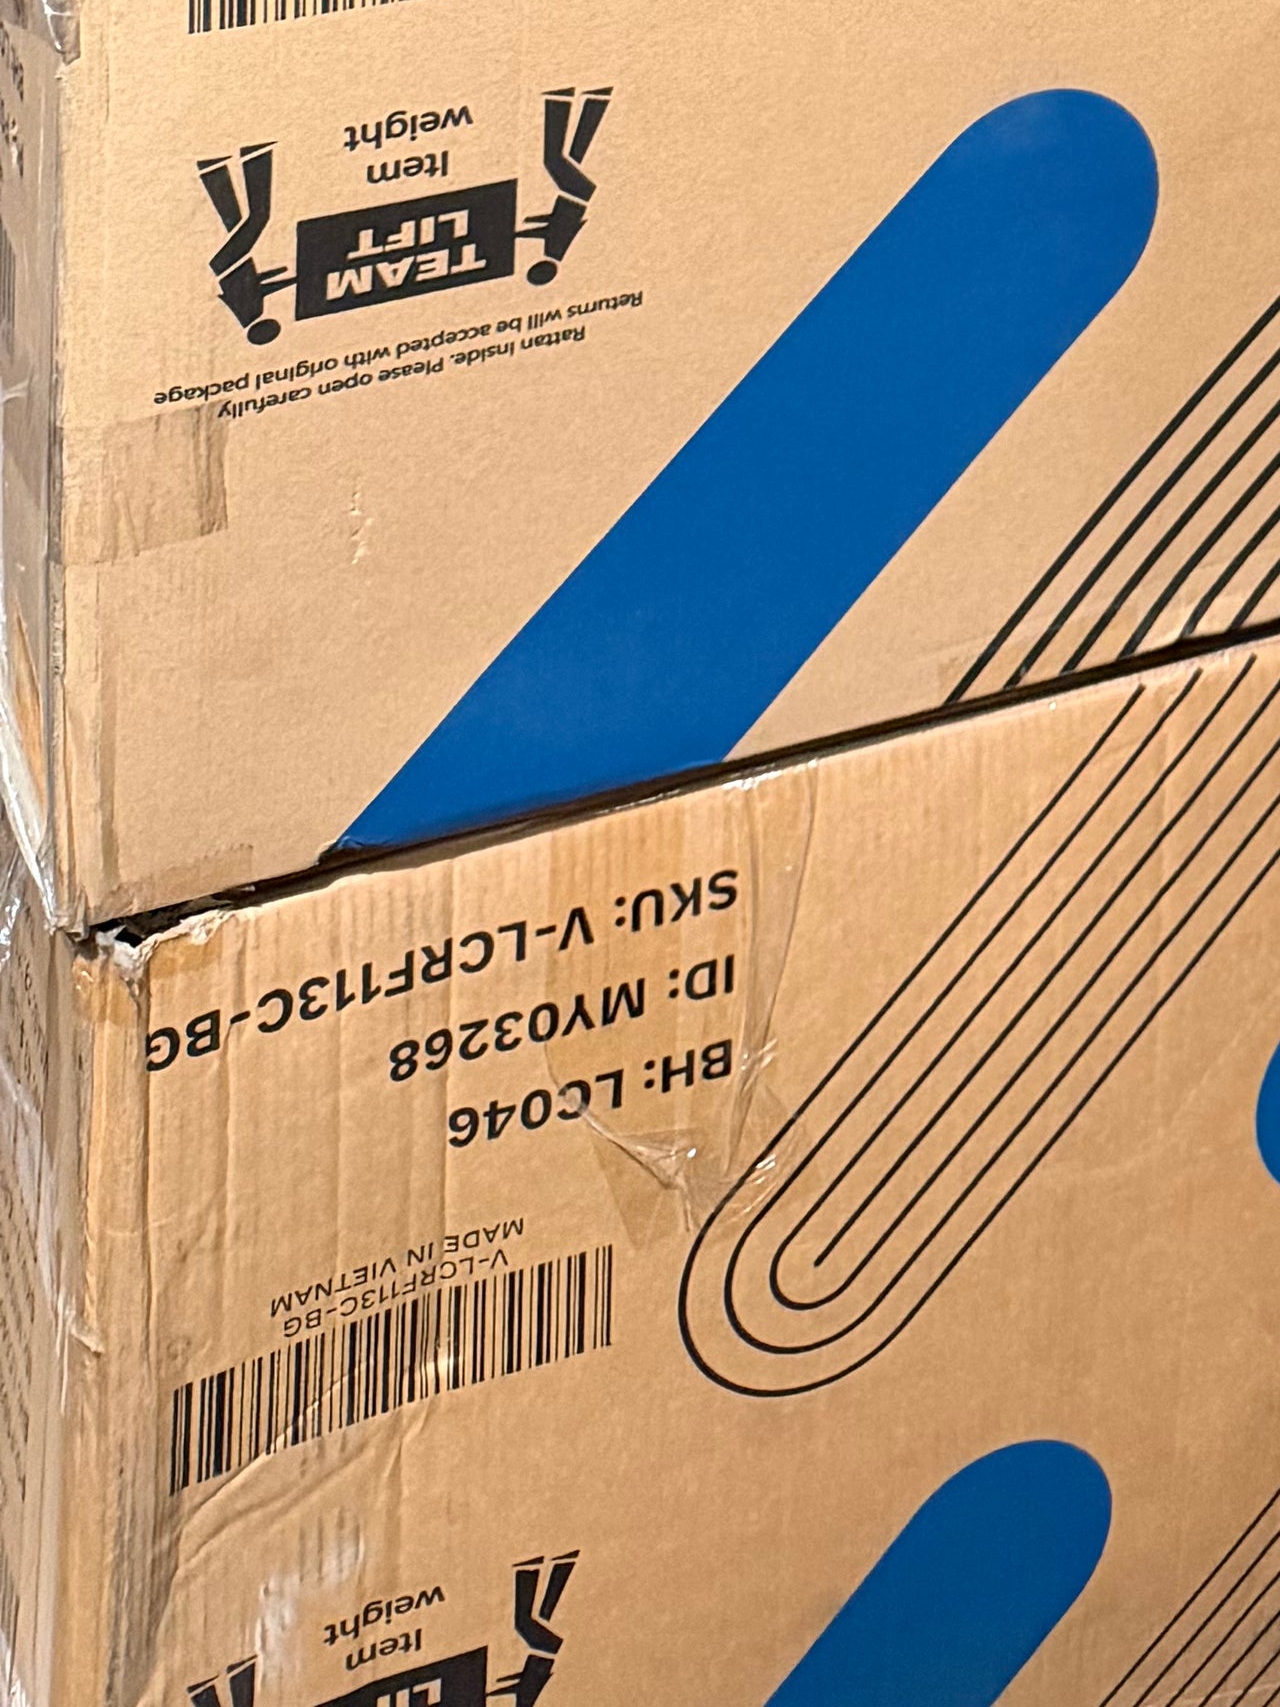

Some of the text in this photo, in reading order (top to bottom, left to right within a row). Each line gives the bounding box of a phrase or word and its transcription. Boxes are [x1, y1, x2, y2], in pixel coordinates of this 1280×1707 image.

[343, 105, 474, 152] weight
[365, 150, 451, 185] Item
[346, 208, 471, 263] LIFT
[324, 243, 487, 302] TEAM
[144, 868, 738, 1073] SKU: V-LCRF113C-BG
[388, 953, 735, 1082] ID: MY03268
[448, 1037, 733, 1148] BH: LC046
[269, 1216, 524, 1318] MADE IN VIETNAM
[282, 1247, 509, 1338] V-LCRF113C-BG
[322, 1585, 447, 1648] weight
[344, 1627, 424, 1672] Item
